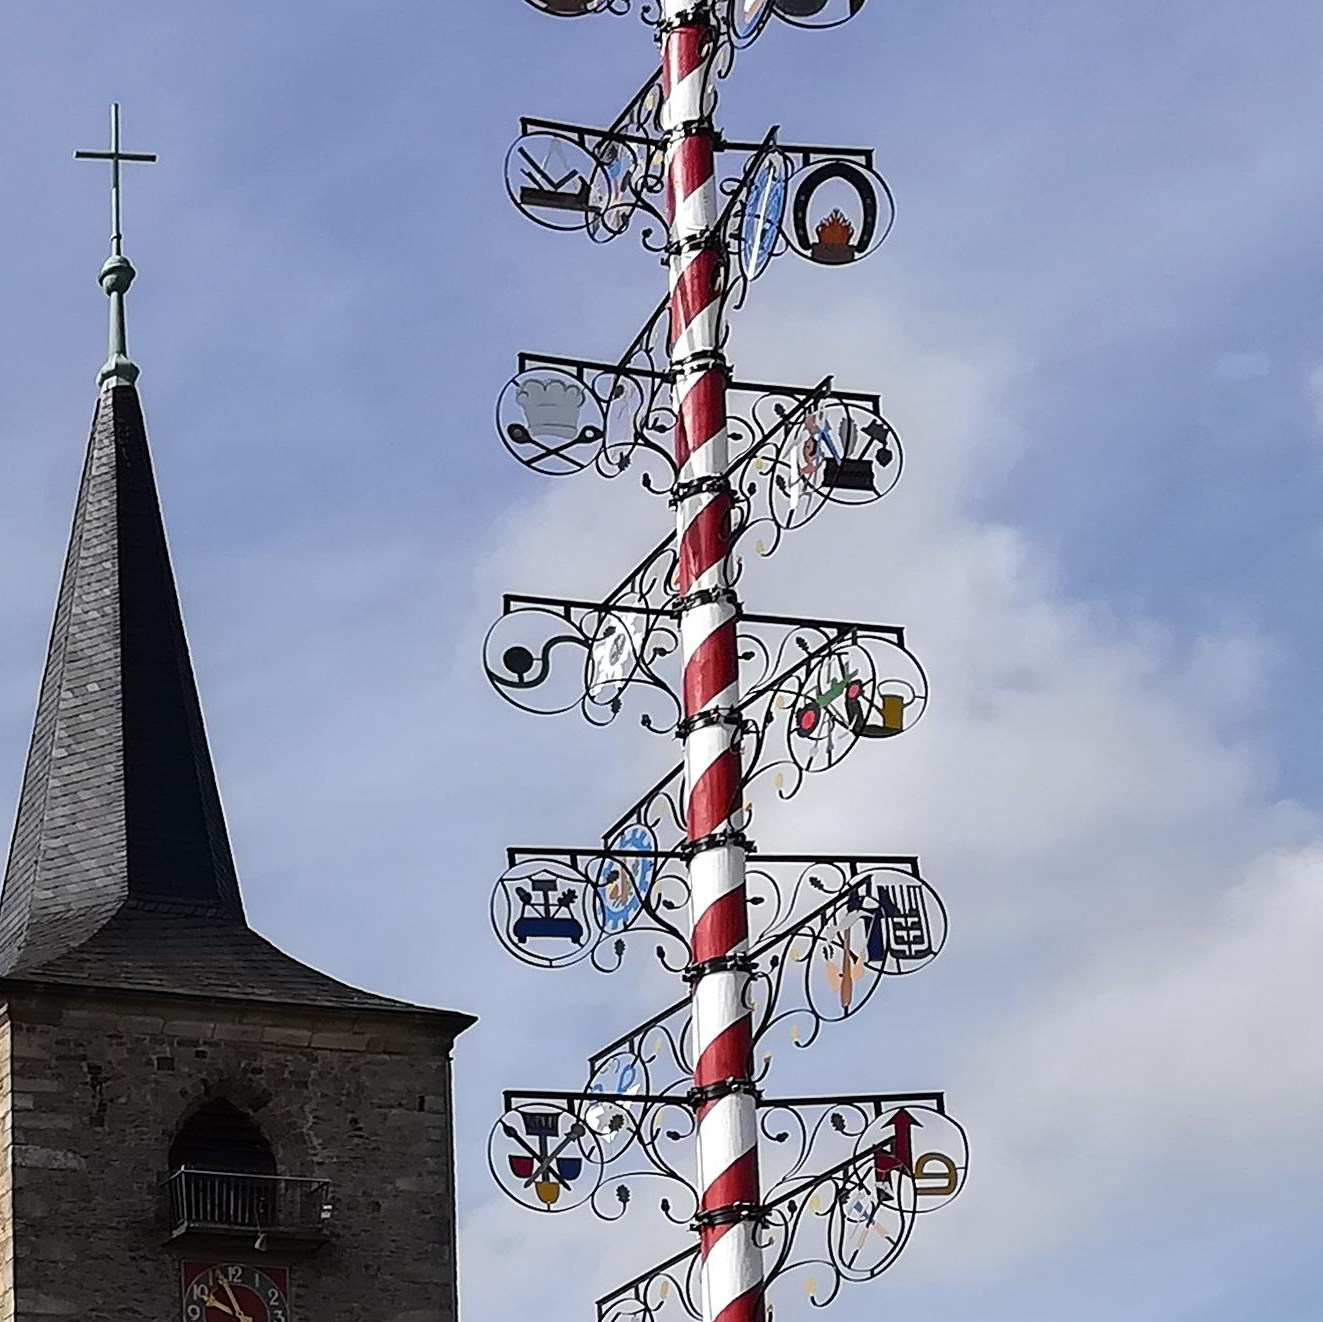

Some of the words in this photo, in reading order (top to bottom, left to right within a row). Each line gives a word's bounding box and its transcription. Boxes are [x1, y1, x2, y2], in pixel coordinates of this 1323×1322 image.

[228, 1266, 243, 1282] 12
[193, 1284, 209, 1300] 10
[267, 1289, 280, 1306] 2
[187, 1304, 201, 1321] 9
